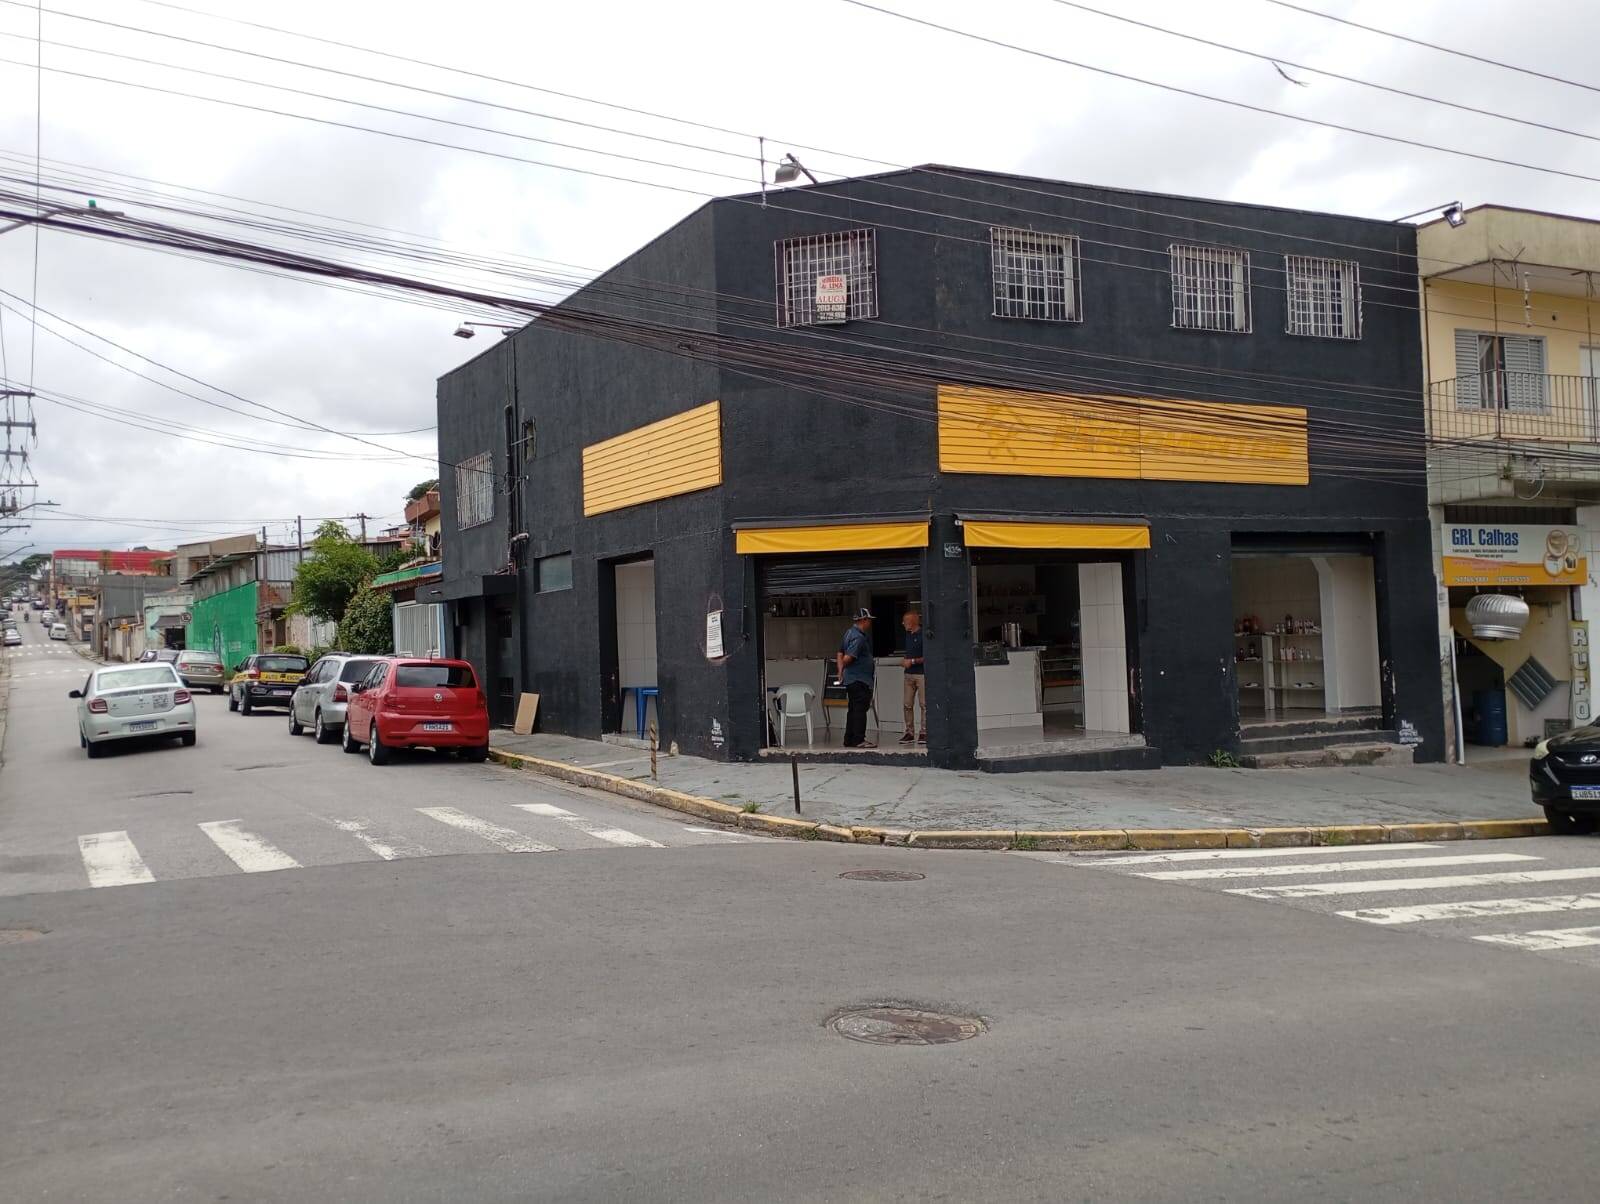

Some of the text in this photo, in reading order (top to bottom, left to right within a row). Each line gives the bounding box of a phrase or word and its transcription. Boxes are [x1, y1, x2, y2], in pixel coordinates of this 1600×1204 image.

[817, 295, 845, 303] ALUGA
[1451, 528, 1519, 546] GRL Calhas
[1571, 628, 1591, 720] RUFO
